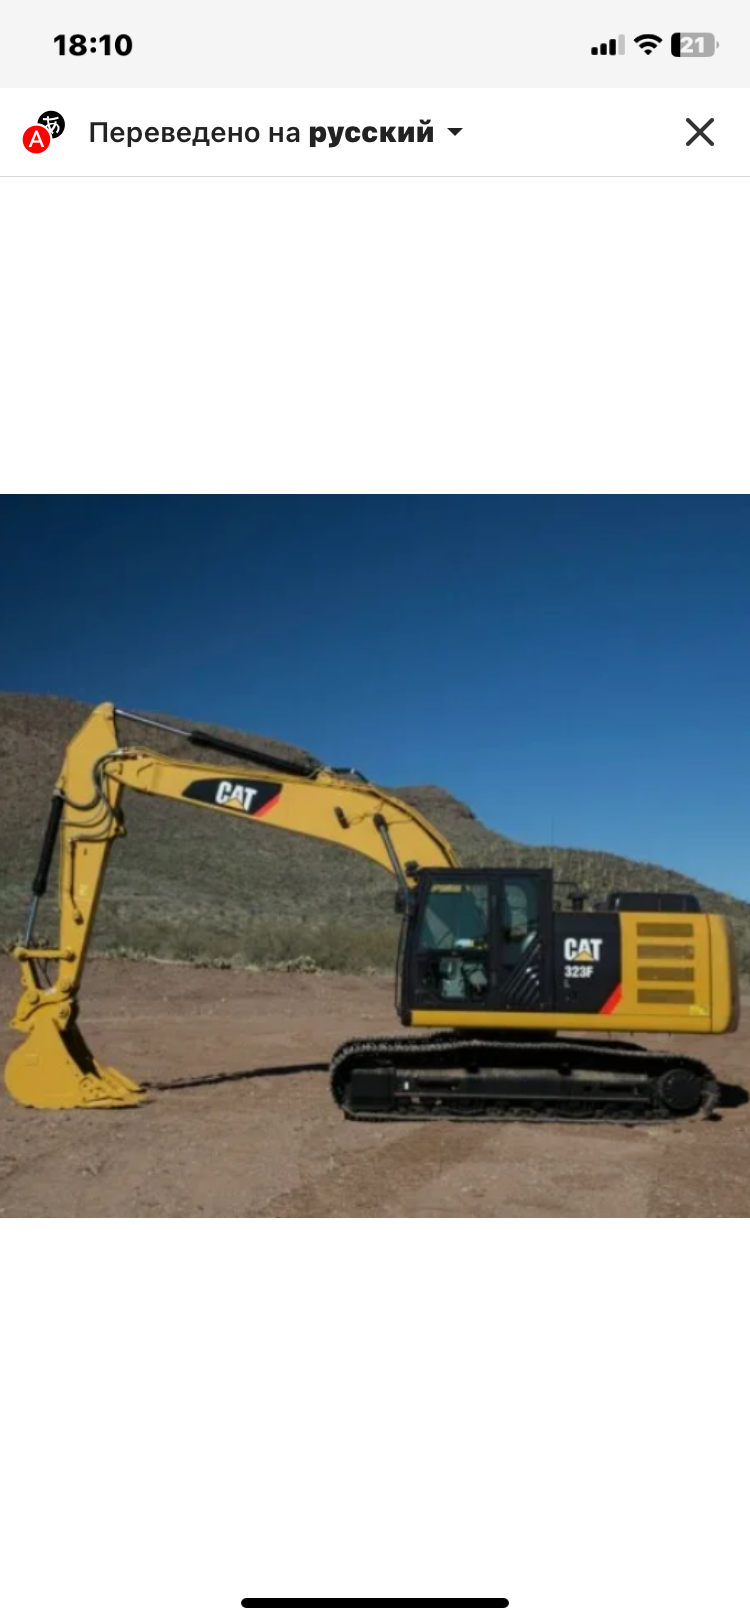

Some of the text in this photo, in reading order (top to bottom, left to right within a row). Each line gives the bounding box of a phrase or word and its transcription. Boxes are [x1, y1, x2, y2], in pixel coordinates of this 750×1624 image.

[53, 33, 133, 56] 18:10
[680, 36, 705, 53] 21
[28, 130, 45, 148] A
[90, 119, 434, 148] Переведено на русский
[215, 780, 258, 812] CAT
[563, 937, 603, 962] CAT
[564, 965, 594, 979] 323F
